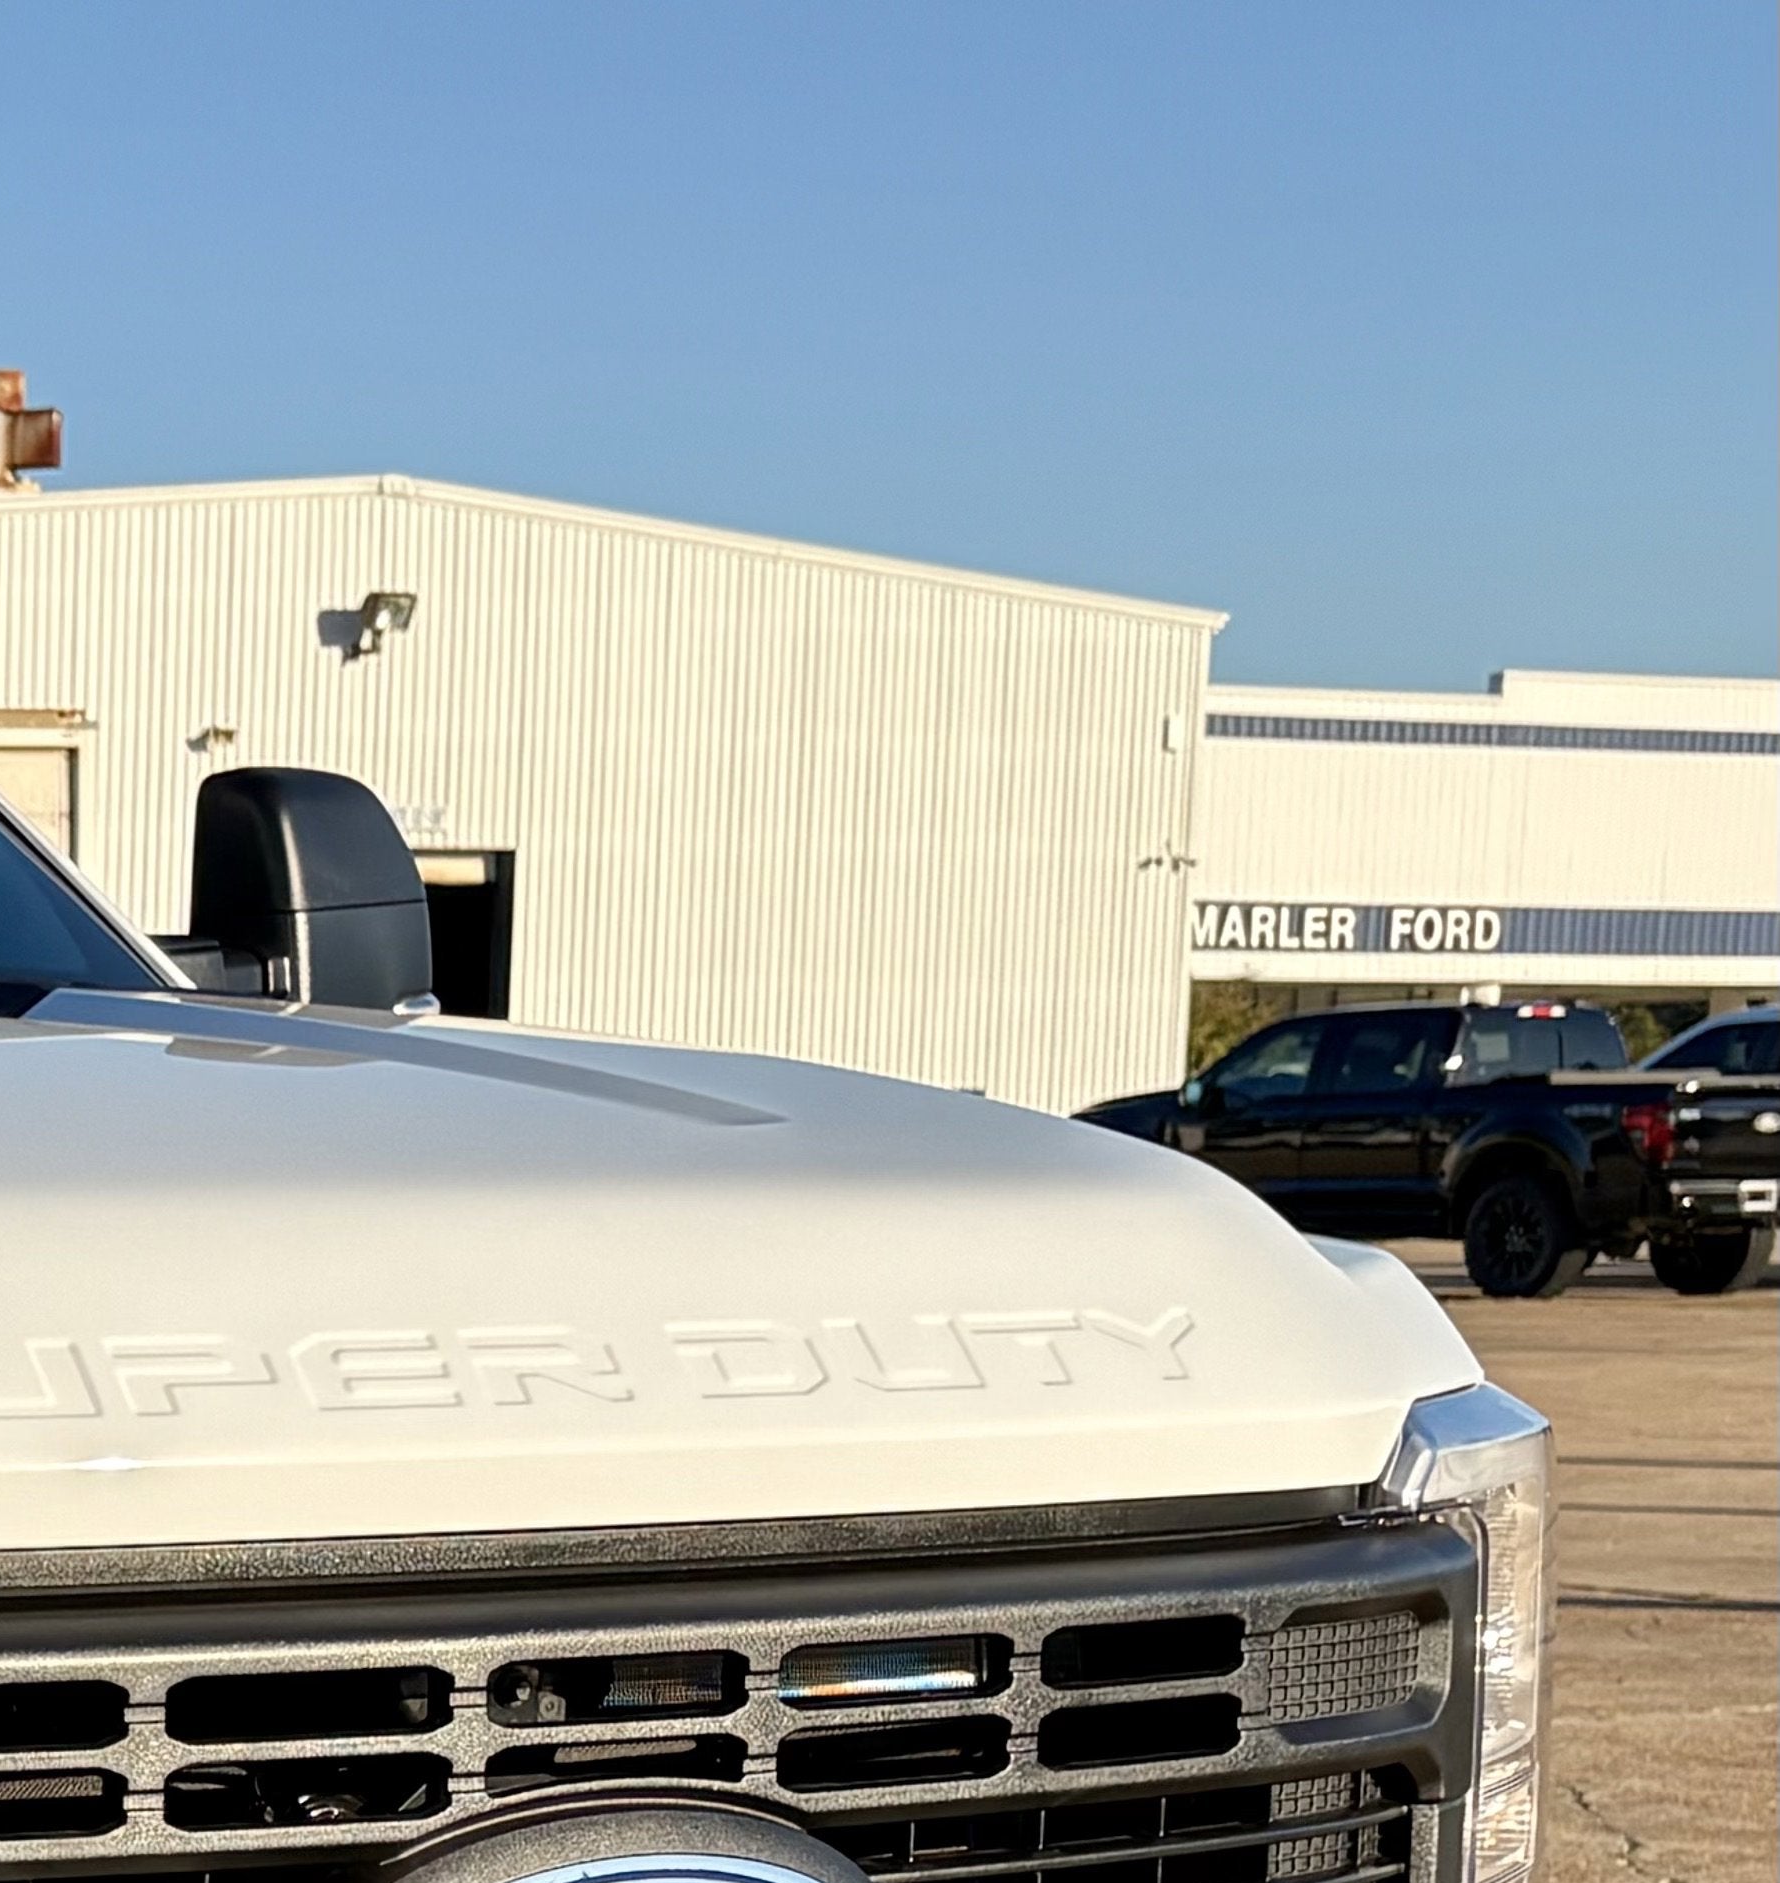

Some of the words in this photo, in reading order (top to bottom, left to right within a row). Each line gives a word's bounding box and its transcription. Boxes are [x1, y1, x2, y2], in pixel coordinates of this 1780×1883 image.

[1191, 905, 1356, 950] MARLER
[1389, 907, 1502, 950] FORD
[664, 1306, 1196, 1399] DUTY
